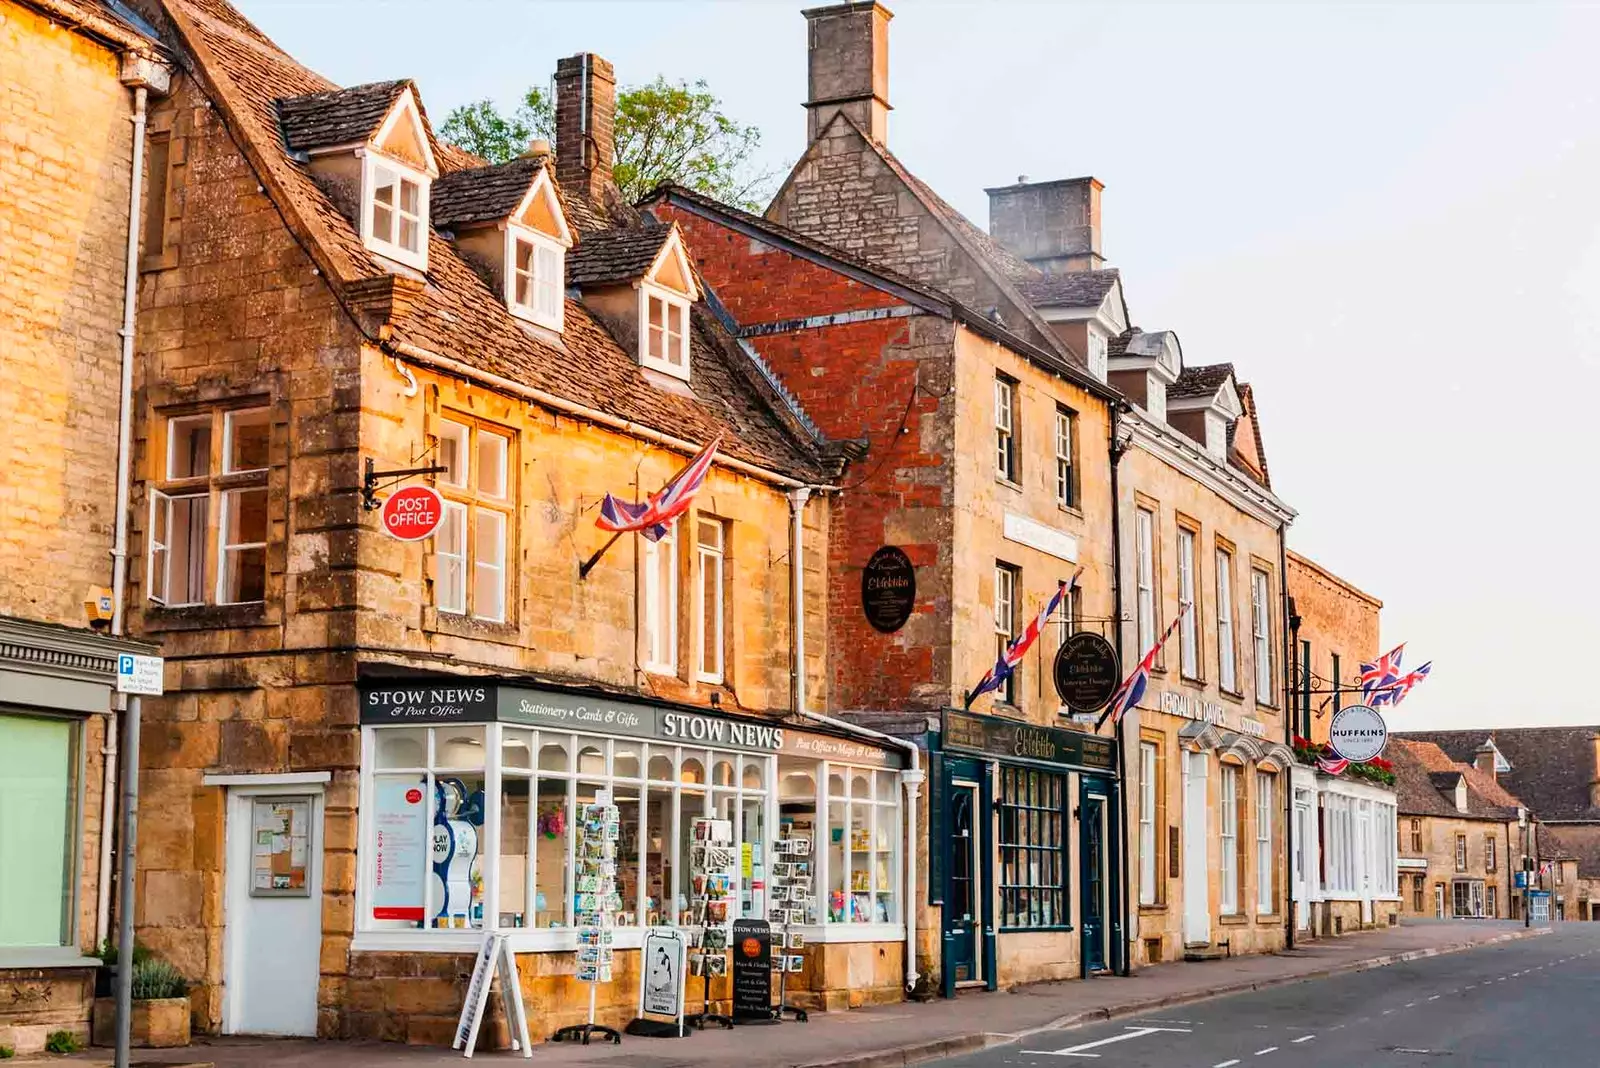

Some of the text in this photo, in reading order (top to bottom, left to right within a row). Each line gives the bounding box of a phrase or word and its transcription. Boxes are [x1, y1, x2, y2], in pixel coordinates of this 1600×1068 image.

[397, 497, 430, 511] POST
[388, 511, 434, 527] OFFICE
[369, 688, 485, 705] STOW NEWS
[390, 704, 464, 717] & Post Office
[519, 699, 640, 727] Stationery Cards & Gifts
[664, 713, 784, 750] STOW NEWS
[1332, 729, 1384, 737] HUFFKINS
[811, 739, 833, 754] Office
